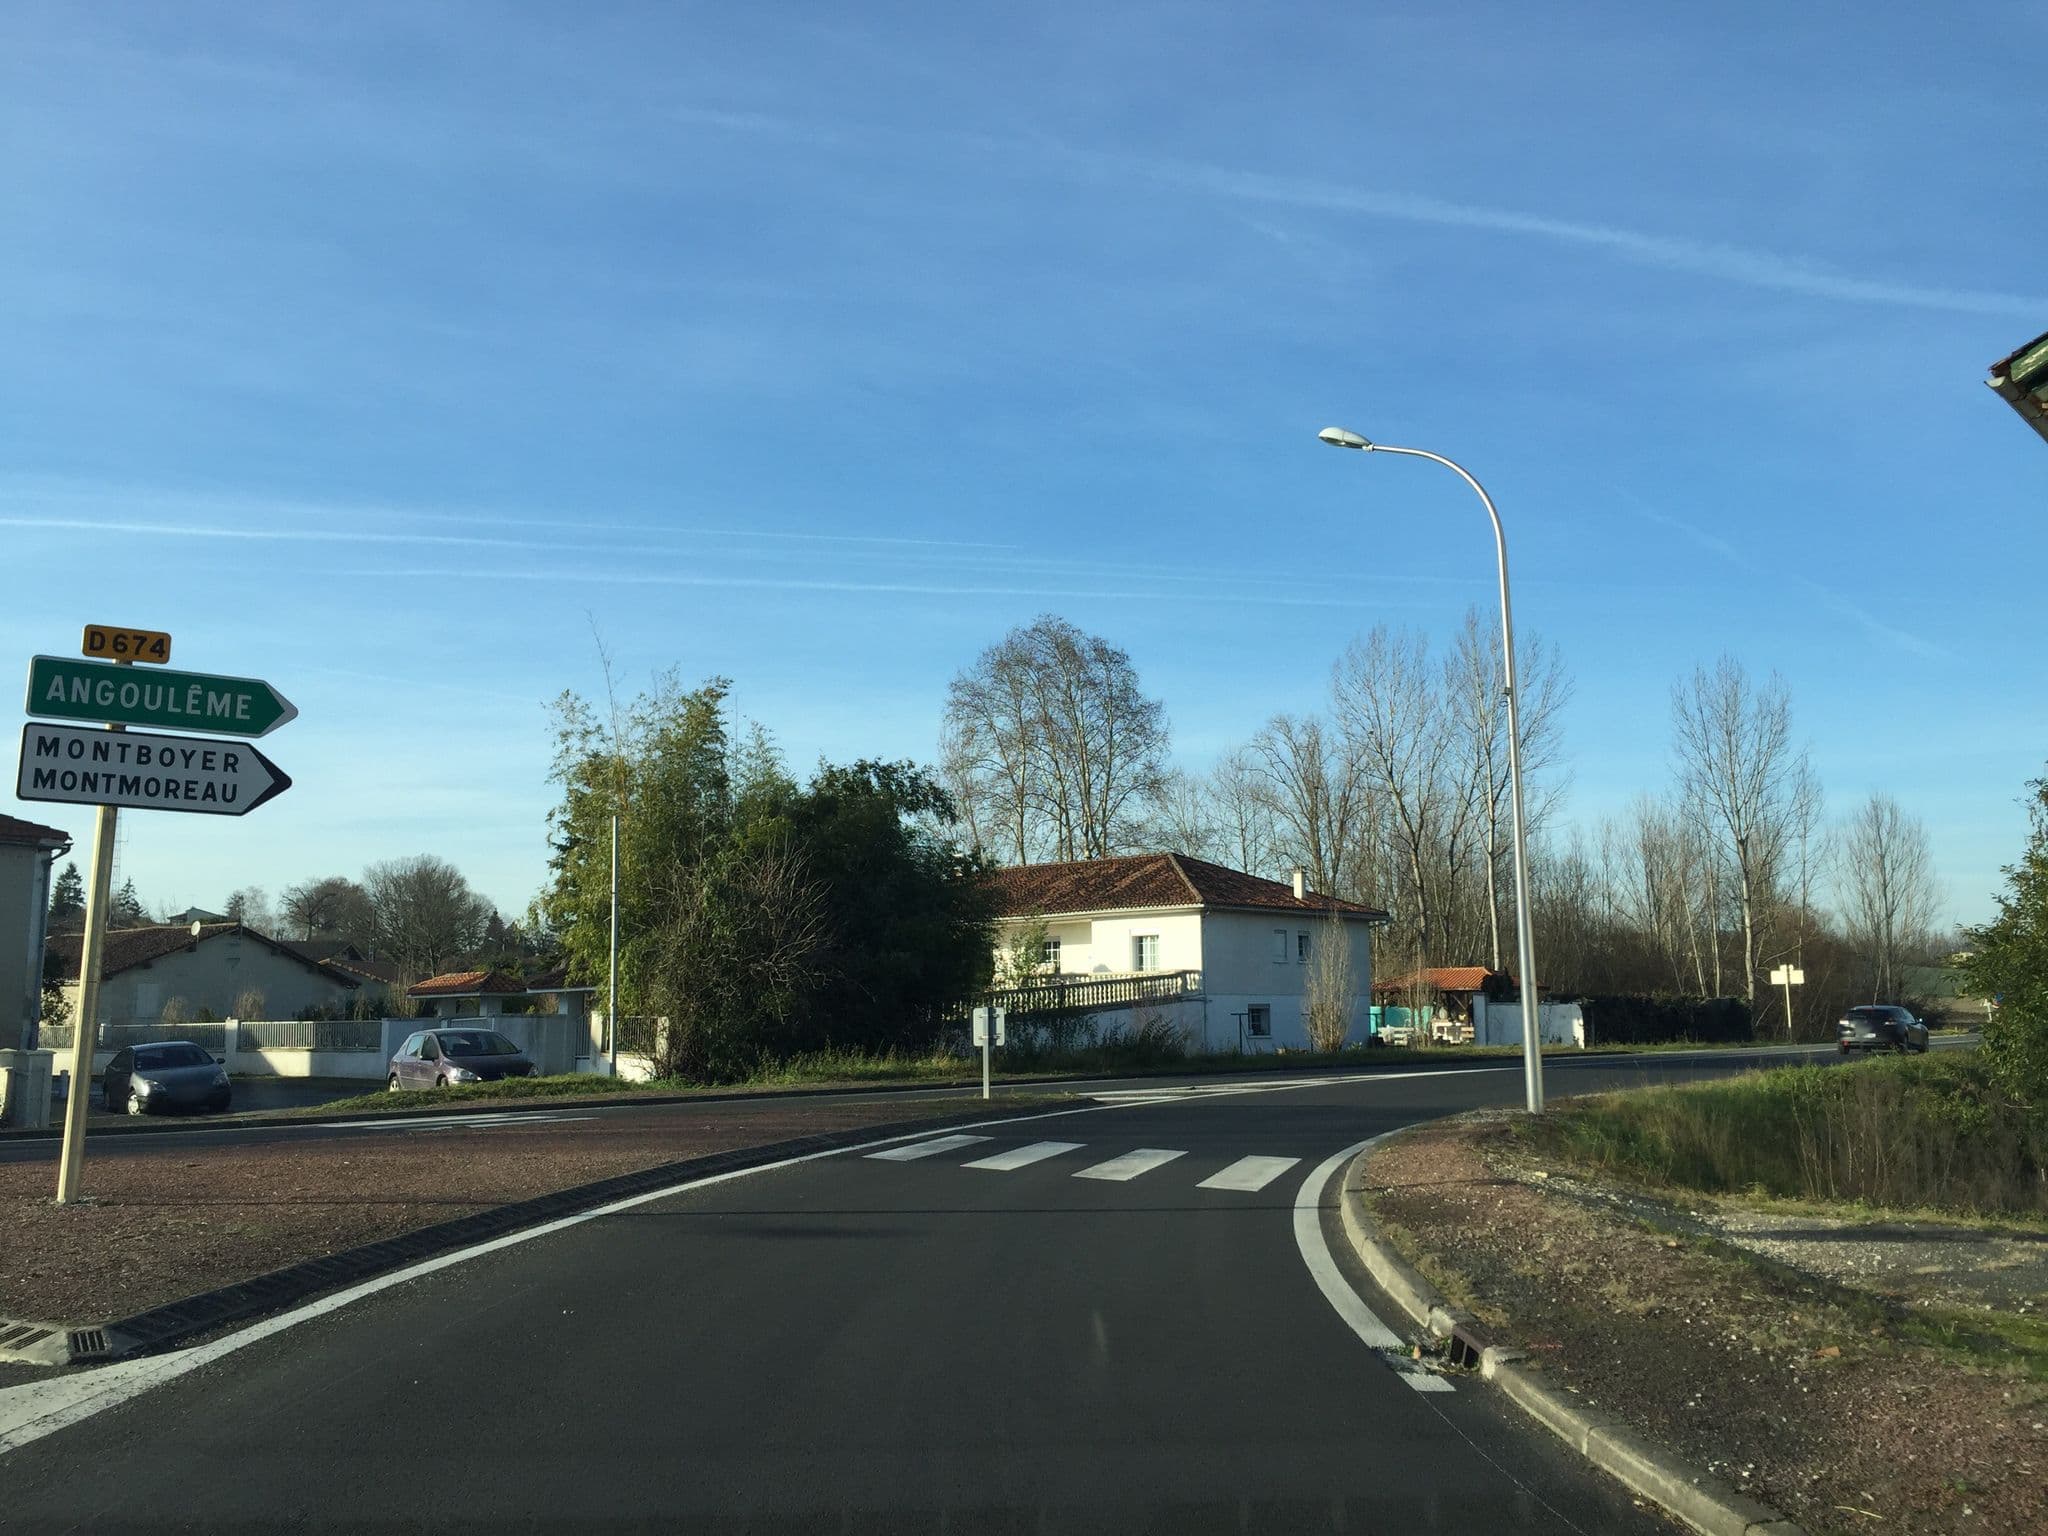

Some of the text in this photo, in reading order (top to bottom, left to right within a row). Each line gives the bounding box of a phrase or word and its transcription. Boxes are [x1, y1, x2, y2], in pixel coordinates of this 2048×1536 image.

[89, 631, 166, 658] D 674
[46, 675, 252, 720] ANGOULÊME
[36, 735, 240, 773] MONTBOYER
[32, 767, 238, 803] MONTMOREAU
